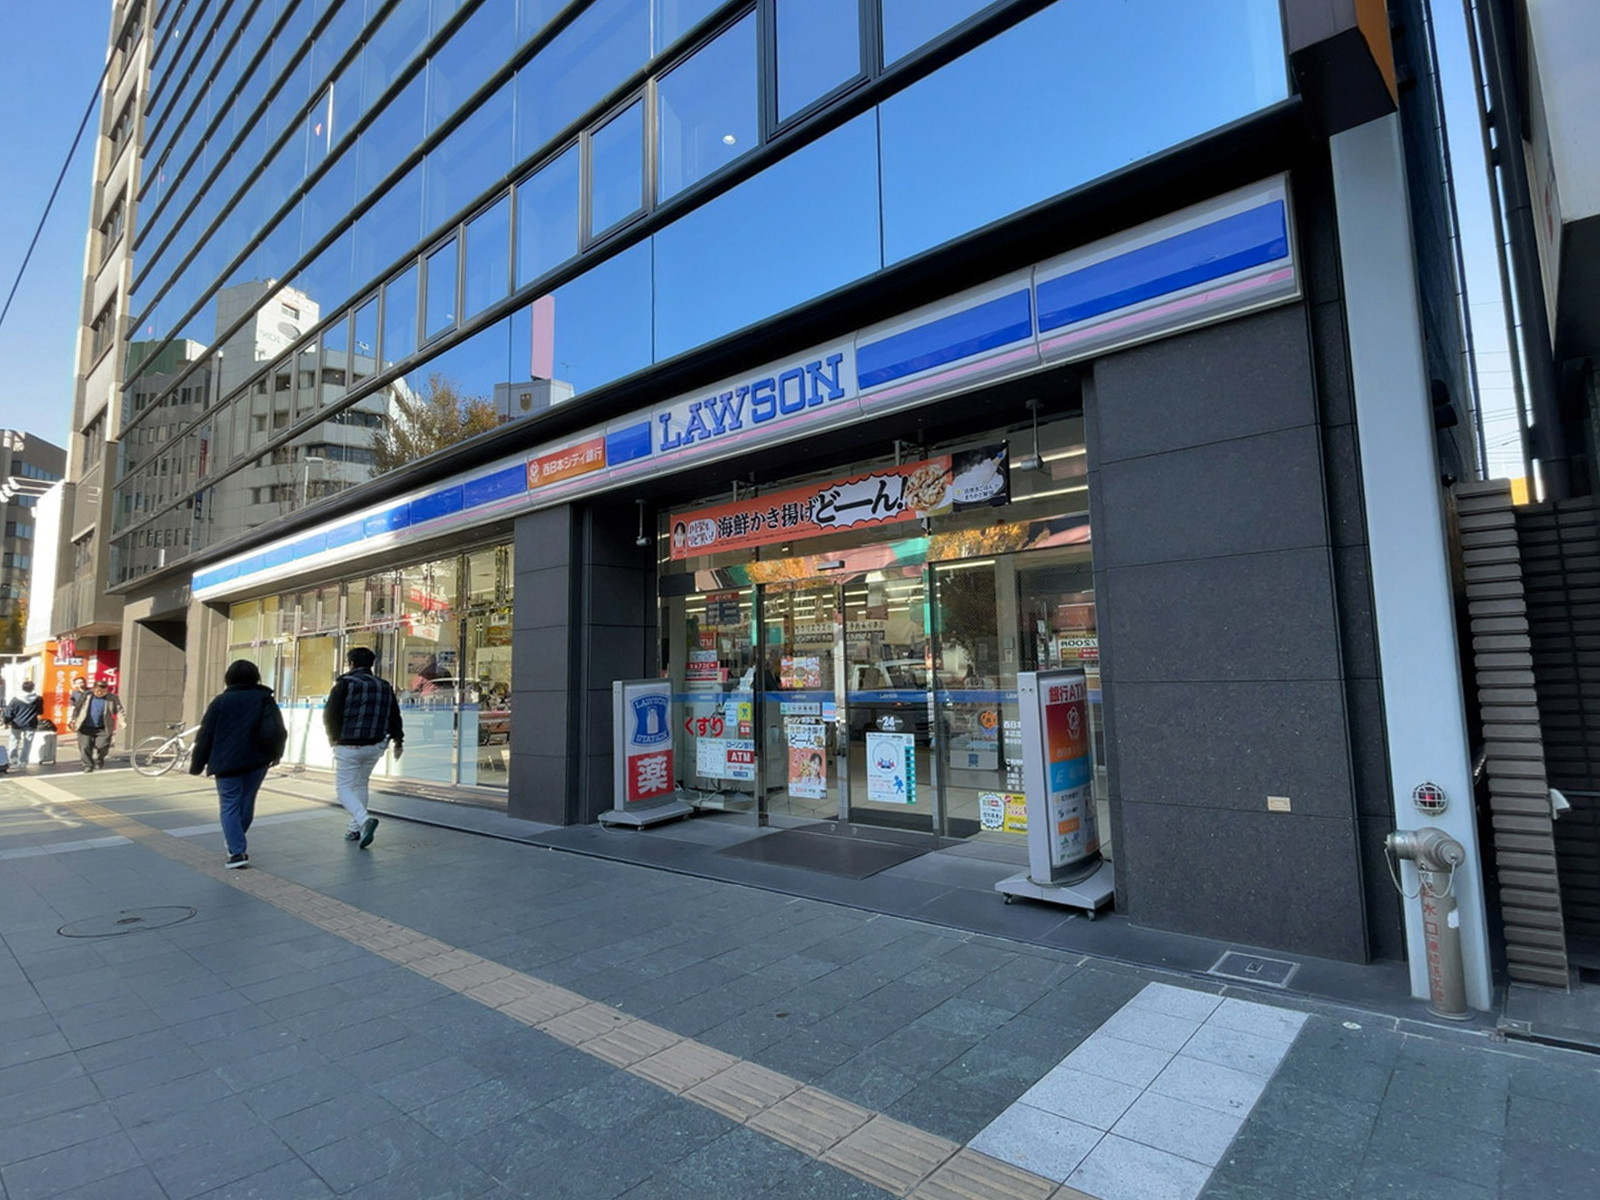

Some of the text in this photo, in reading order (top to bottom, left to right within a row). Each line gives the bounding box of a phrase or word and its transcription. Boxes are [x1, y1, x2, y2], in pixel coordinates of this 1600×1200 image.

[659, 353, 845, 451] LAWSON
[543, 446, 603, 476] 西日本シティ銀行
[684, 716, 724, 738] くすり
[882, 716, 895, 726] 24
[730, 751, 751, 762] ATM
[637, 756, 668, 794] 薬
